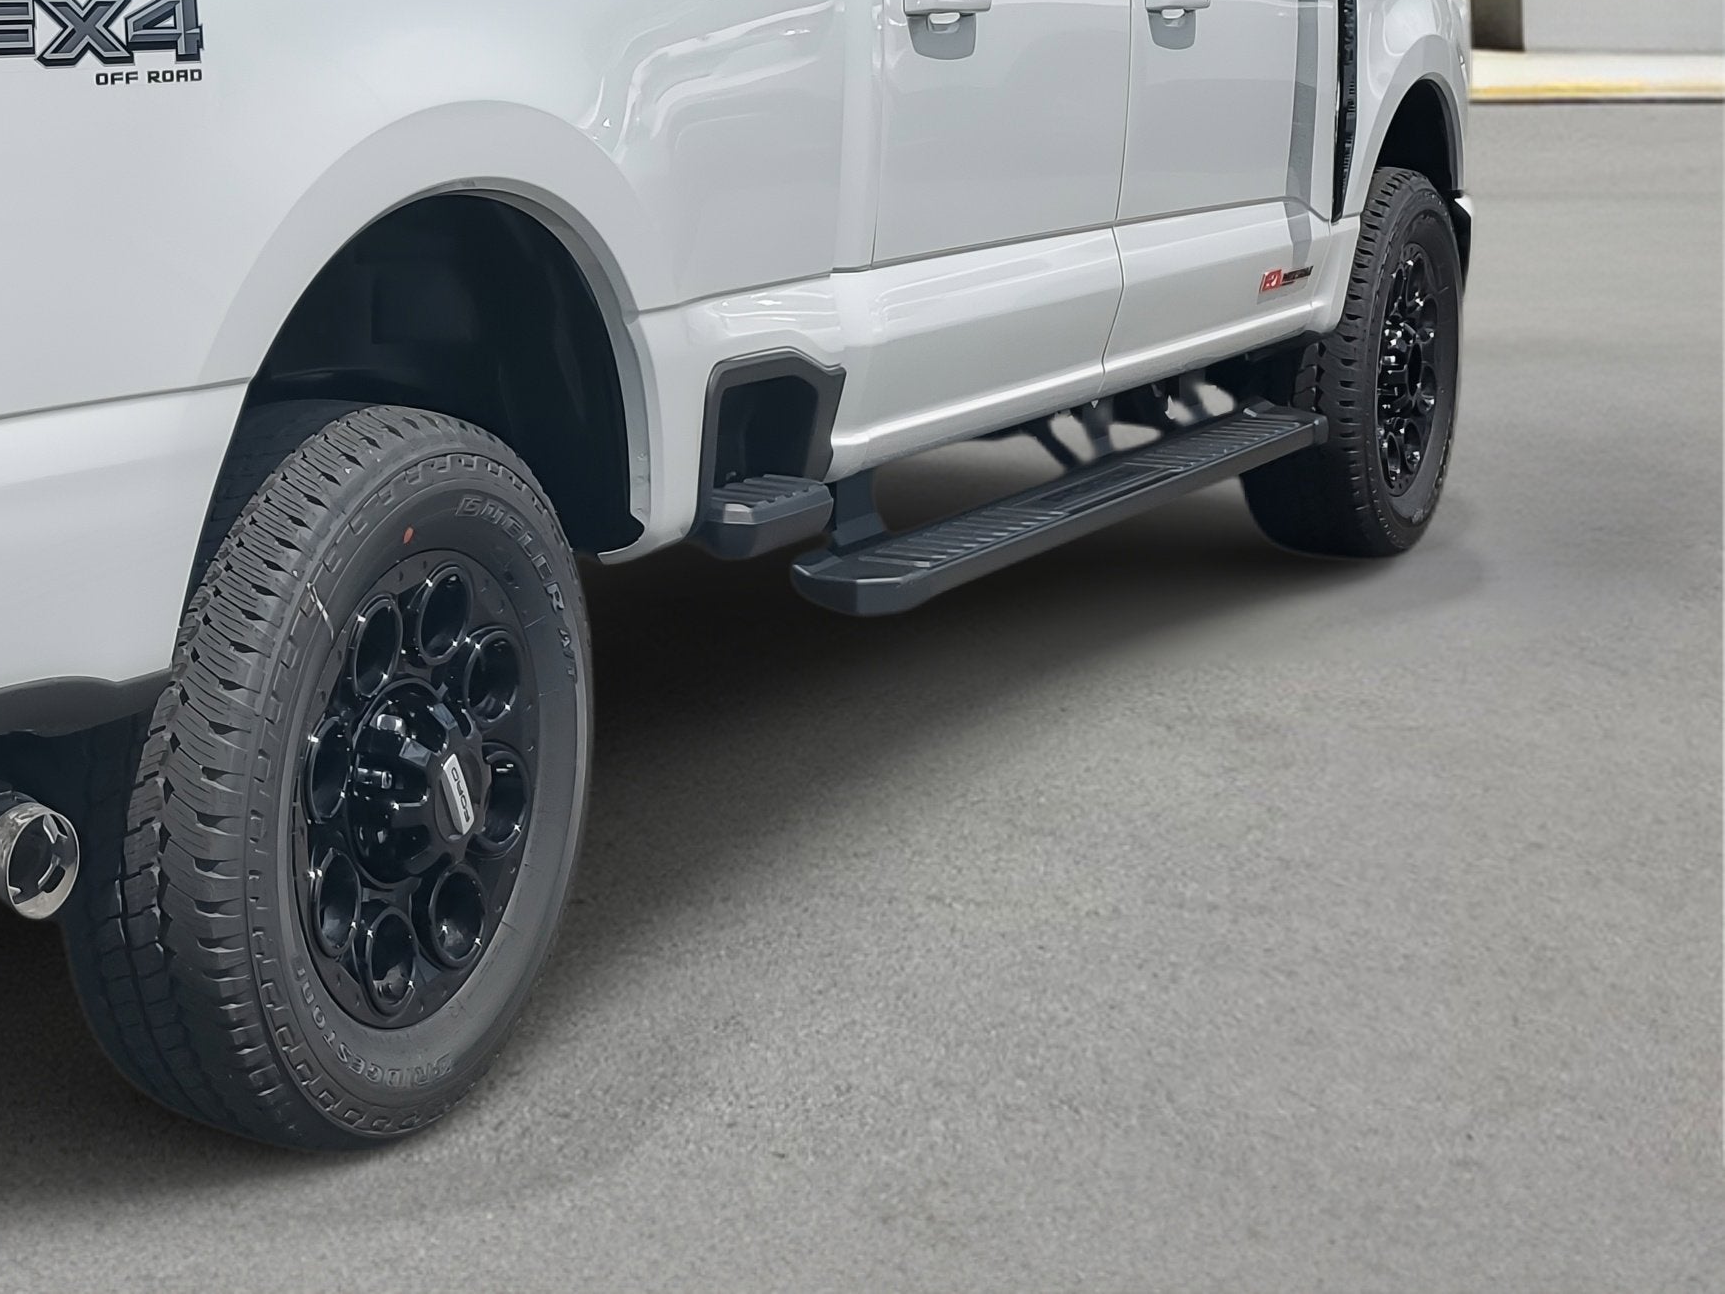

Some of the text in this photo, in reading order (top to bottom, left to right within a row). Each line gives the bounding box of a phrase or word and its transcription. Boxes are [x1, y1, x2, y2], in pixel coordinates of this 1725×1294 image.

[95, 69, 203, 86] OFF ROAD
[451, 767, 470, 823] FORD
